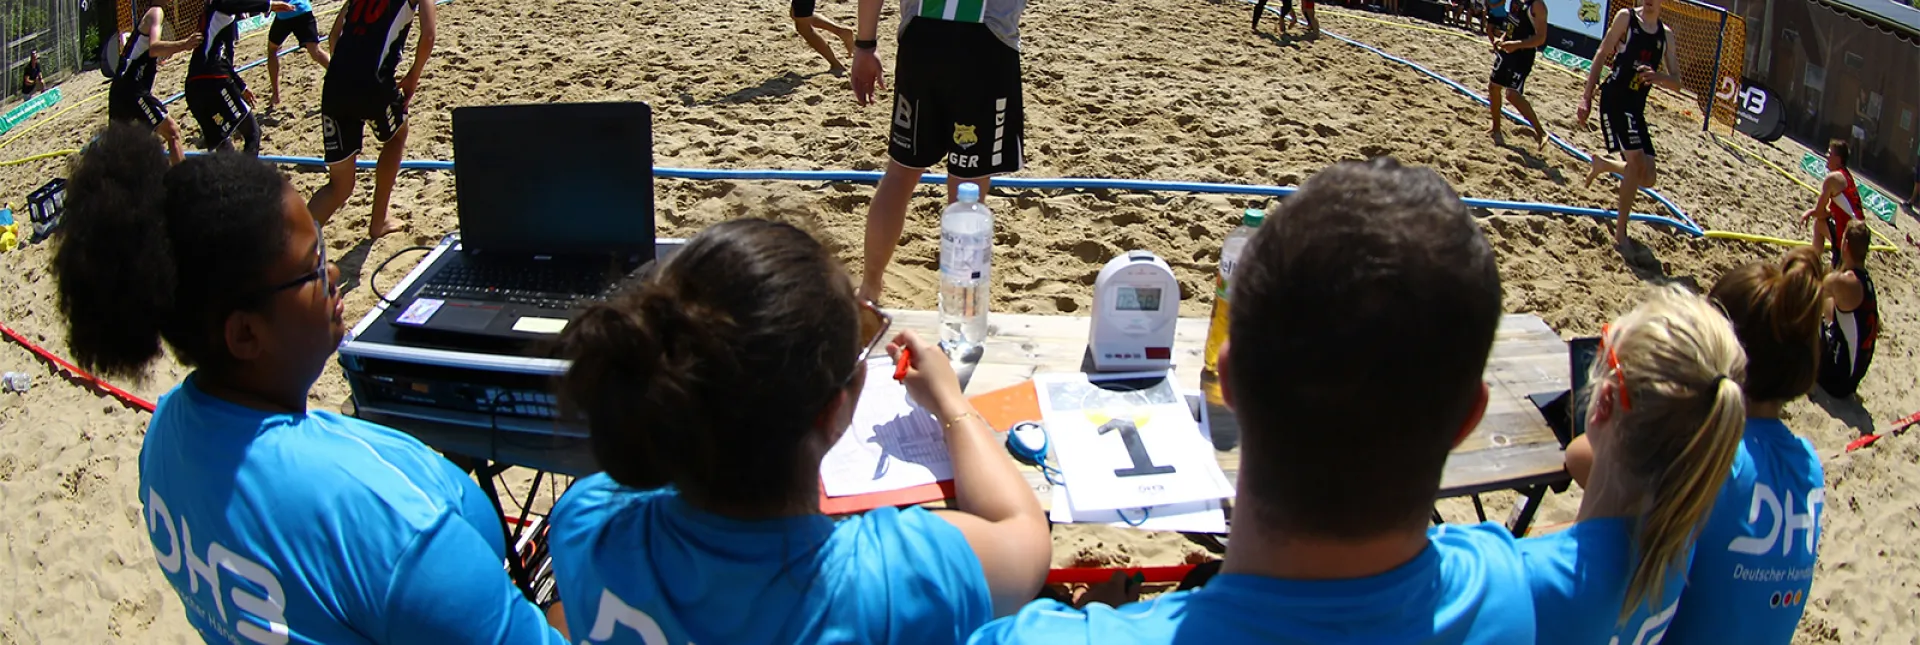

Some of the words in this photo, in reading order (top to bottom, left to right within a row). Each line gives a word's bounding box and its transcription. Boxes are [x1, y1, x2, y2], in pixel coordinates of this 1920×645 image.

[949, 152, 979, 168] GER
[1097, 418, 1176, 478] 1
[1733, 563, 1784, 581] Deutscher
